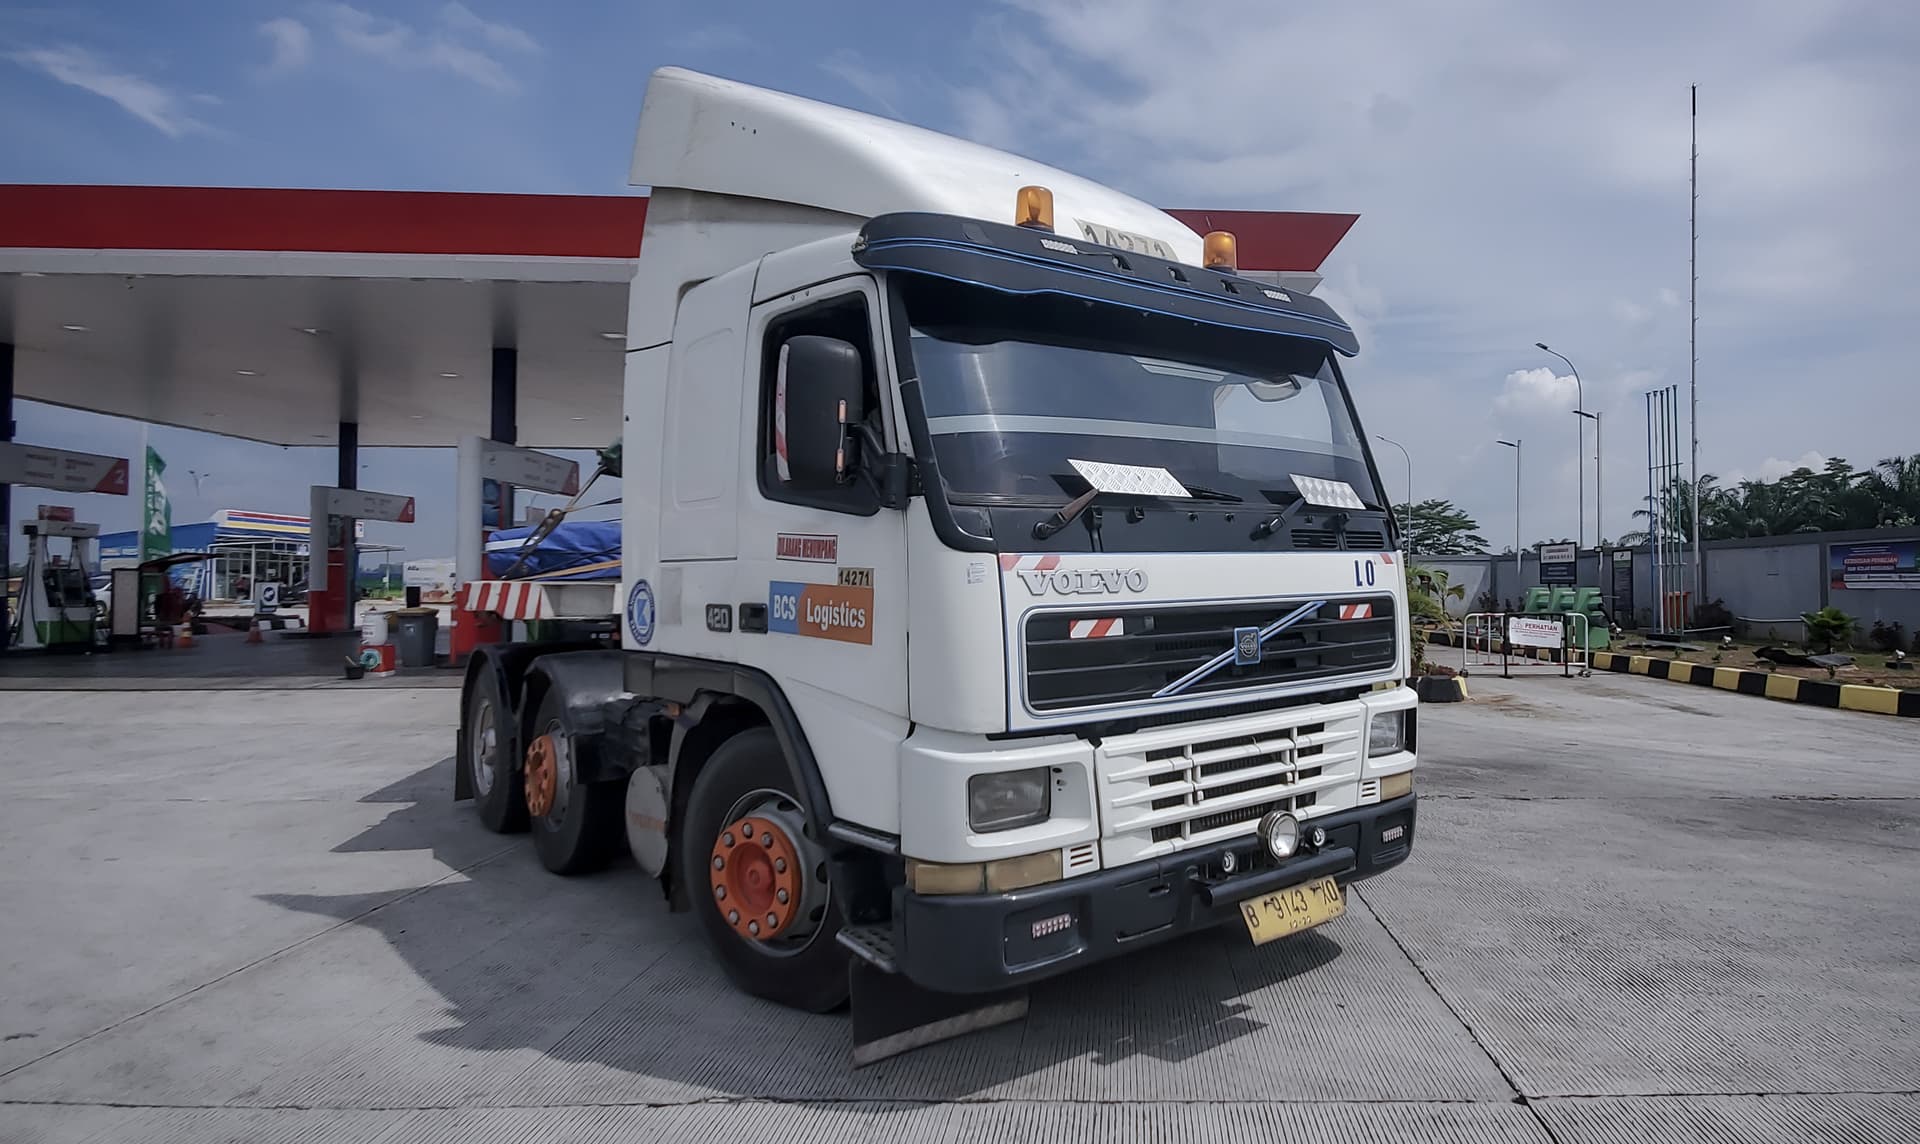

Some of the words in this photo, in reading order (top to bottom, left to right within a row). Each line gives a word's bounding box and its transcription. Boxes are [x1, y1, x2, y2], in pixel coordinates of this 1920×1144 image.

[839, 570, 870, 586] 14271
[1017, 567, 1149, 596] VOLVO
[707, 607, 730, 628] 420
[773, 594, 797, 621] BCS
[806, 597, 866, 632] Logistics
[1525, 623, 1558, 632] PERHATIAN
[1246, 905, 1260, 928] B
[1271, 889, 1308, 919] 9143
